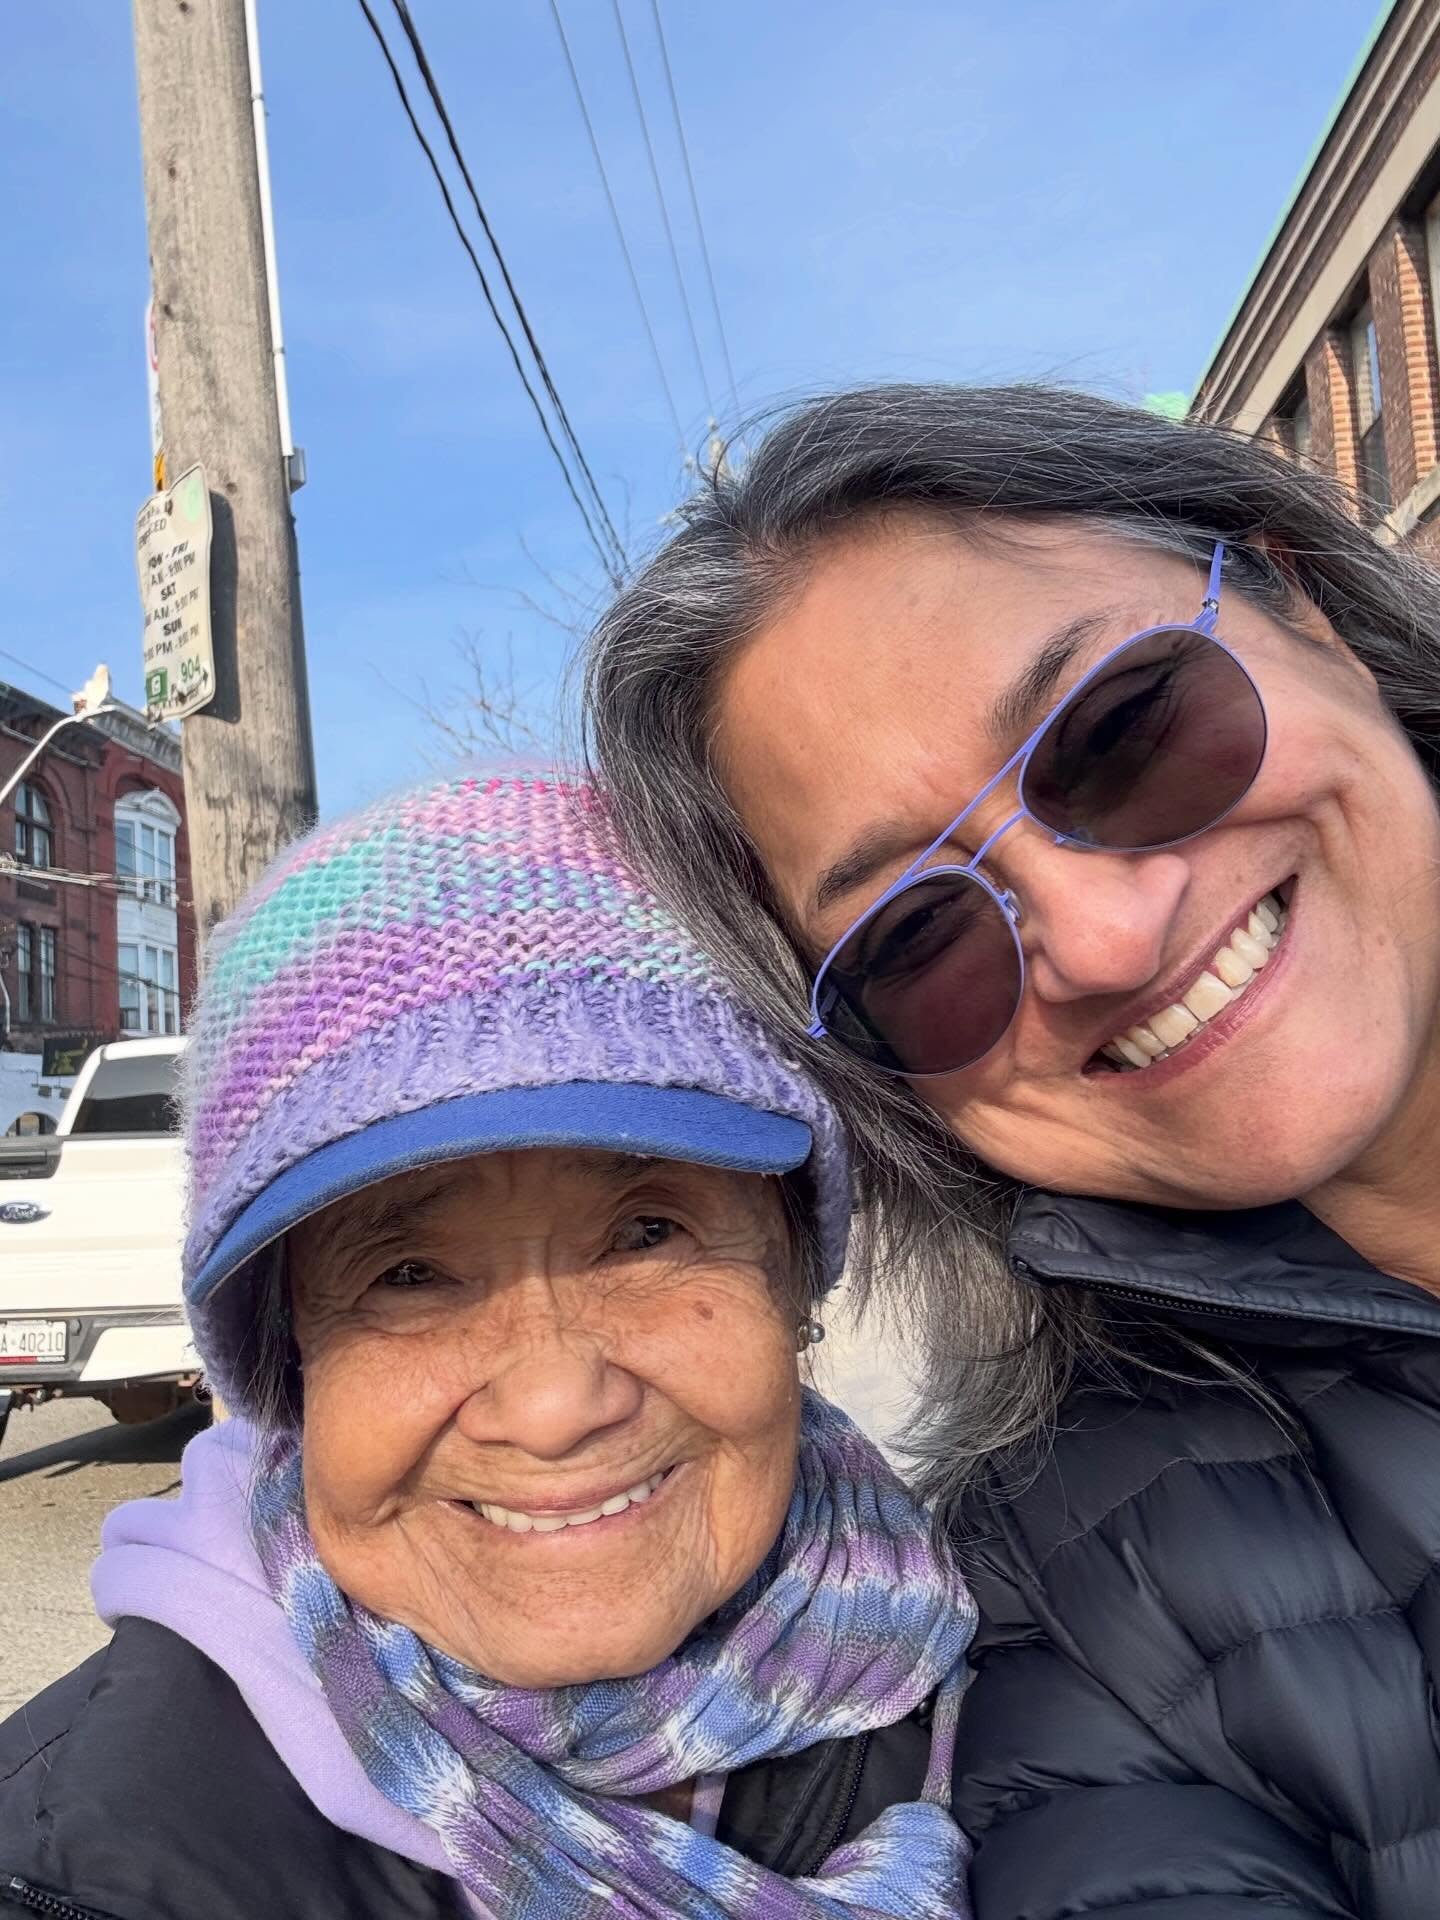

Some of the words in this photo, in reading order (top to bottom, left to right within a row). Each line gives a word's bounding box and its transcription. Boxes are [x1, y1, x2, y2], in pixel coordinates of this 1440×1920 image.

[171, 540, 188, 557] FRI
[161, 582, 176, 601] SAT
[163, 617, 182, 636] SUN
[156, 640, 173, 656] PM
[181, 653, 200, 682] 904
